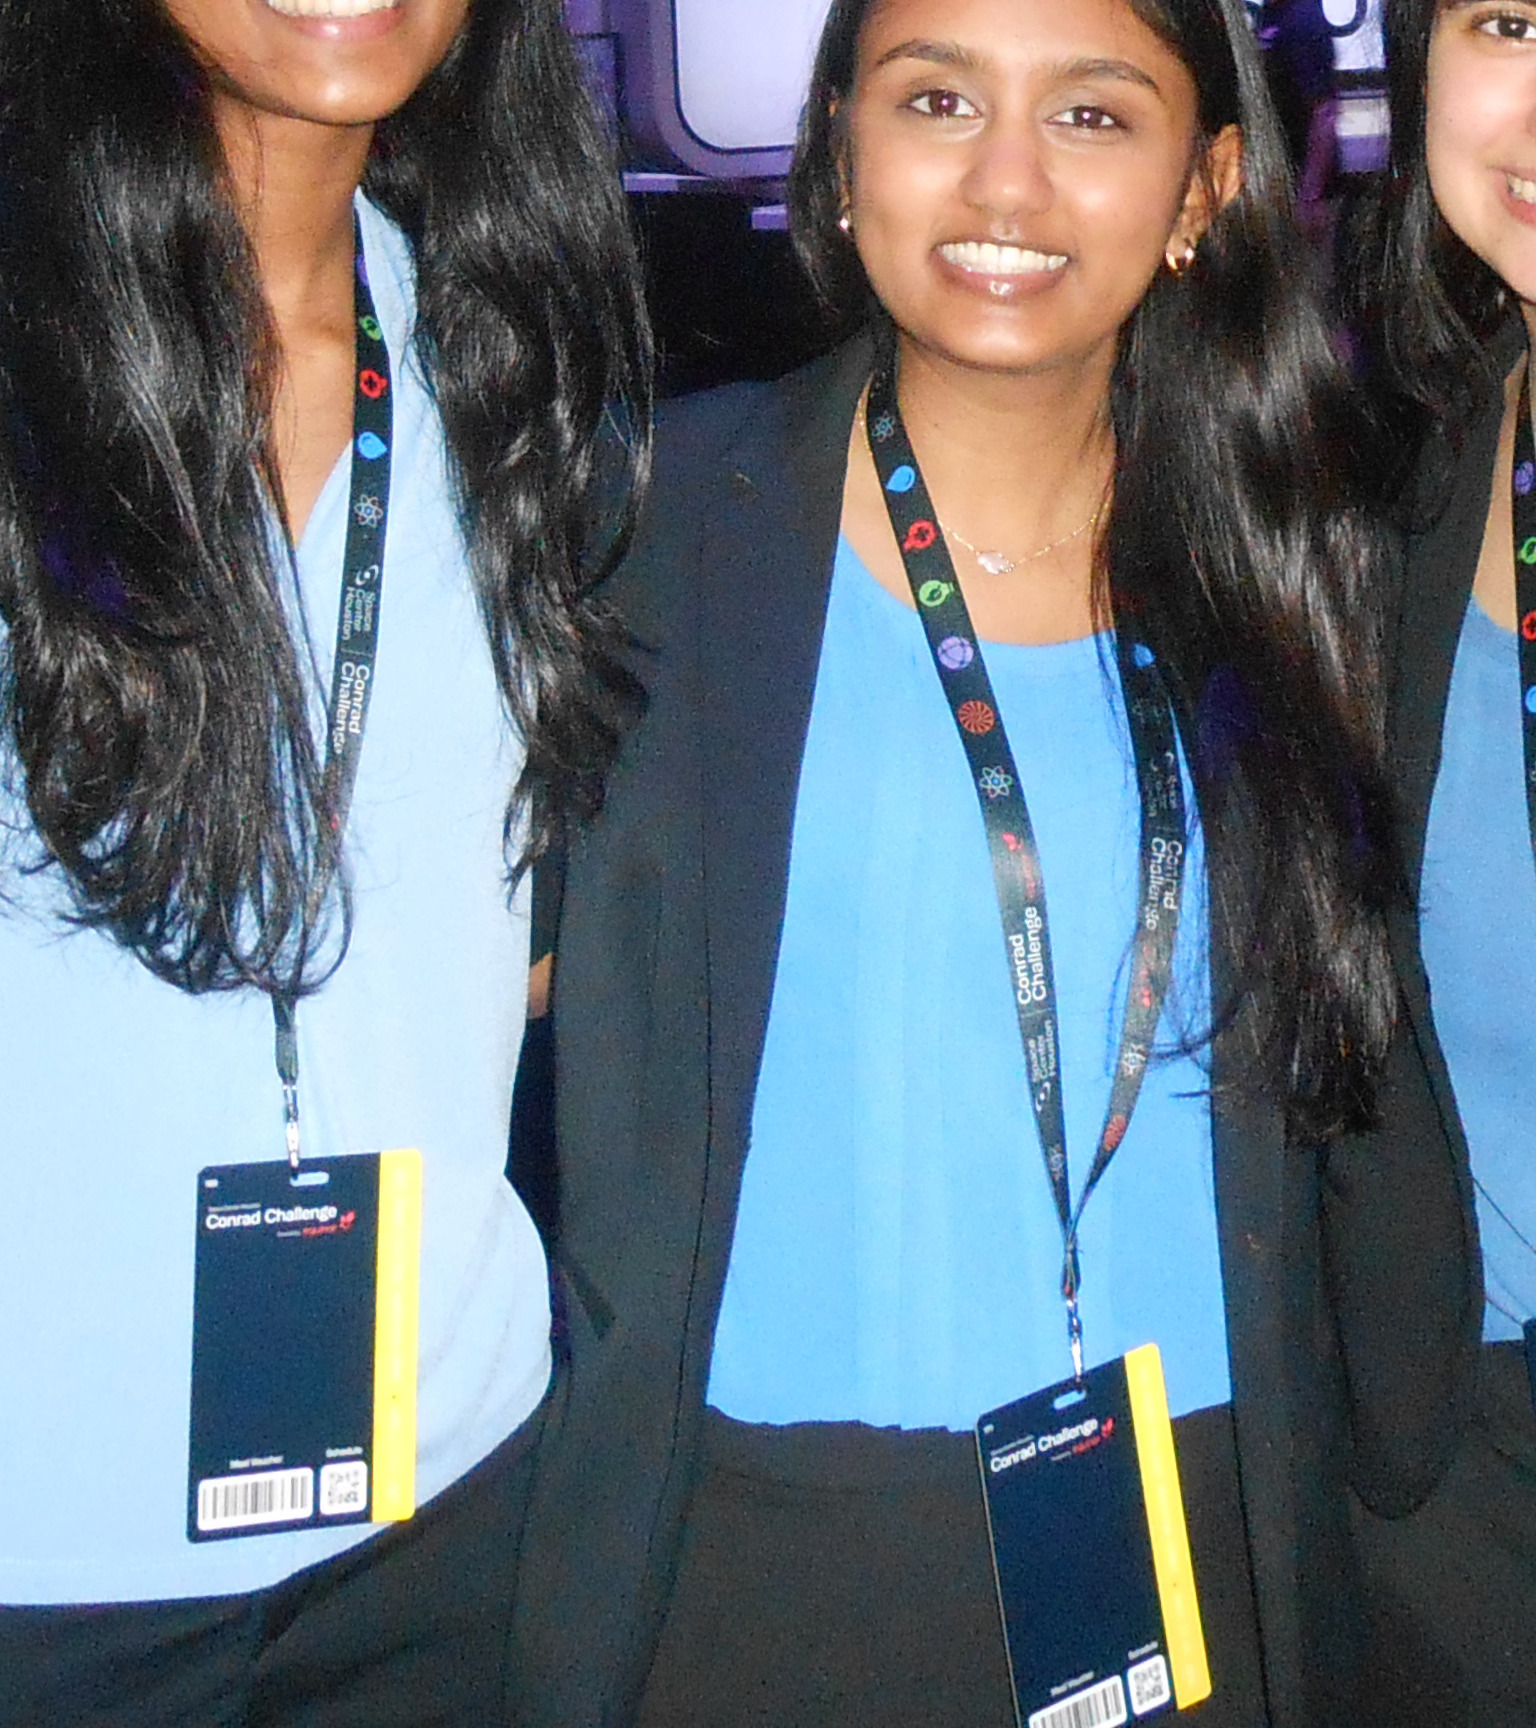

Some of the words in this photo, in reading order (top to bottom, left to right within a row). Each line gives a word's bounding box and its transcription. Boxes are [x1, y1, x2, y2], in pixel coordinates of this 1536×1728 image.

[332, 661, 356, 755] Challenge
[348, 665, 370, 734] Conrad
[1008, 933, 1031, 1005] Conrad
[1025, 906, 1047, 1001] Challenge
[205, 1210, 261, 1230] Conrad
[264, 1205, 338, 1224] Challenge
[990, 1441, 1037, 1473] Conrad
[1037, 1418, 1099, 1452] Challenge
